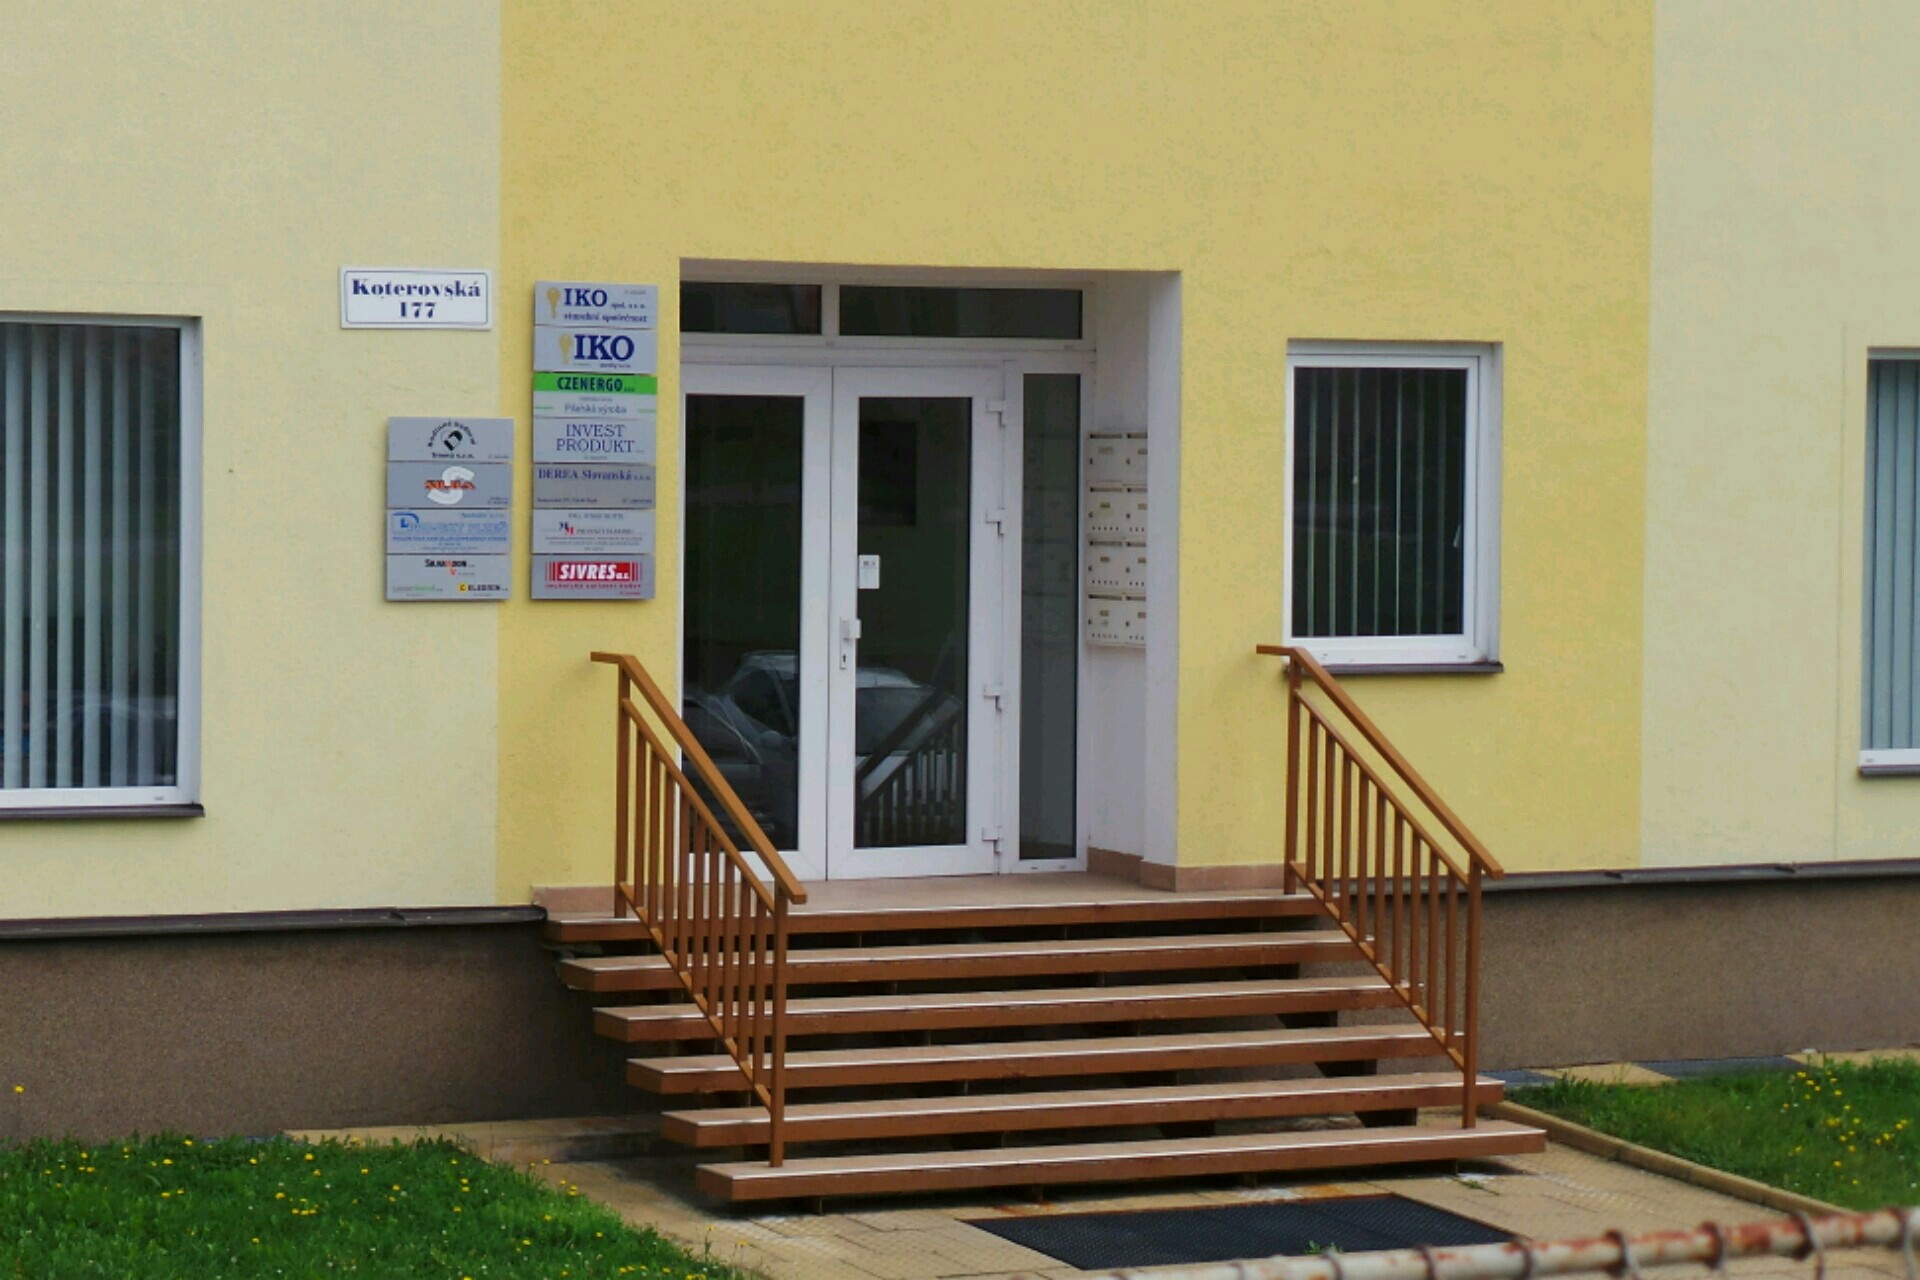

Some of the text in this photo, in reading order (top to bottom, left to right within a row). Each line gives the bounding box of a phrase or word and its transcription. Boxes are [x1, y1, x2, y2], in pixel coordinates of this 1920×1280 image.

[352, 278, 481, 297] Koterovská
[563, 288, 608, 307] IKO
[400, 301, 436, 318] 177
[574, 333, 635, 362] IKO
[557, 376, 623, 392] CZENERGO
[566, 424, 625, 438] INVEST
[556, 438, 635, 453] PRODUKT
[538, 468, 578, 479] DEREA
[559, 564, 617, 580] SIVRES
